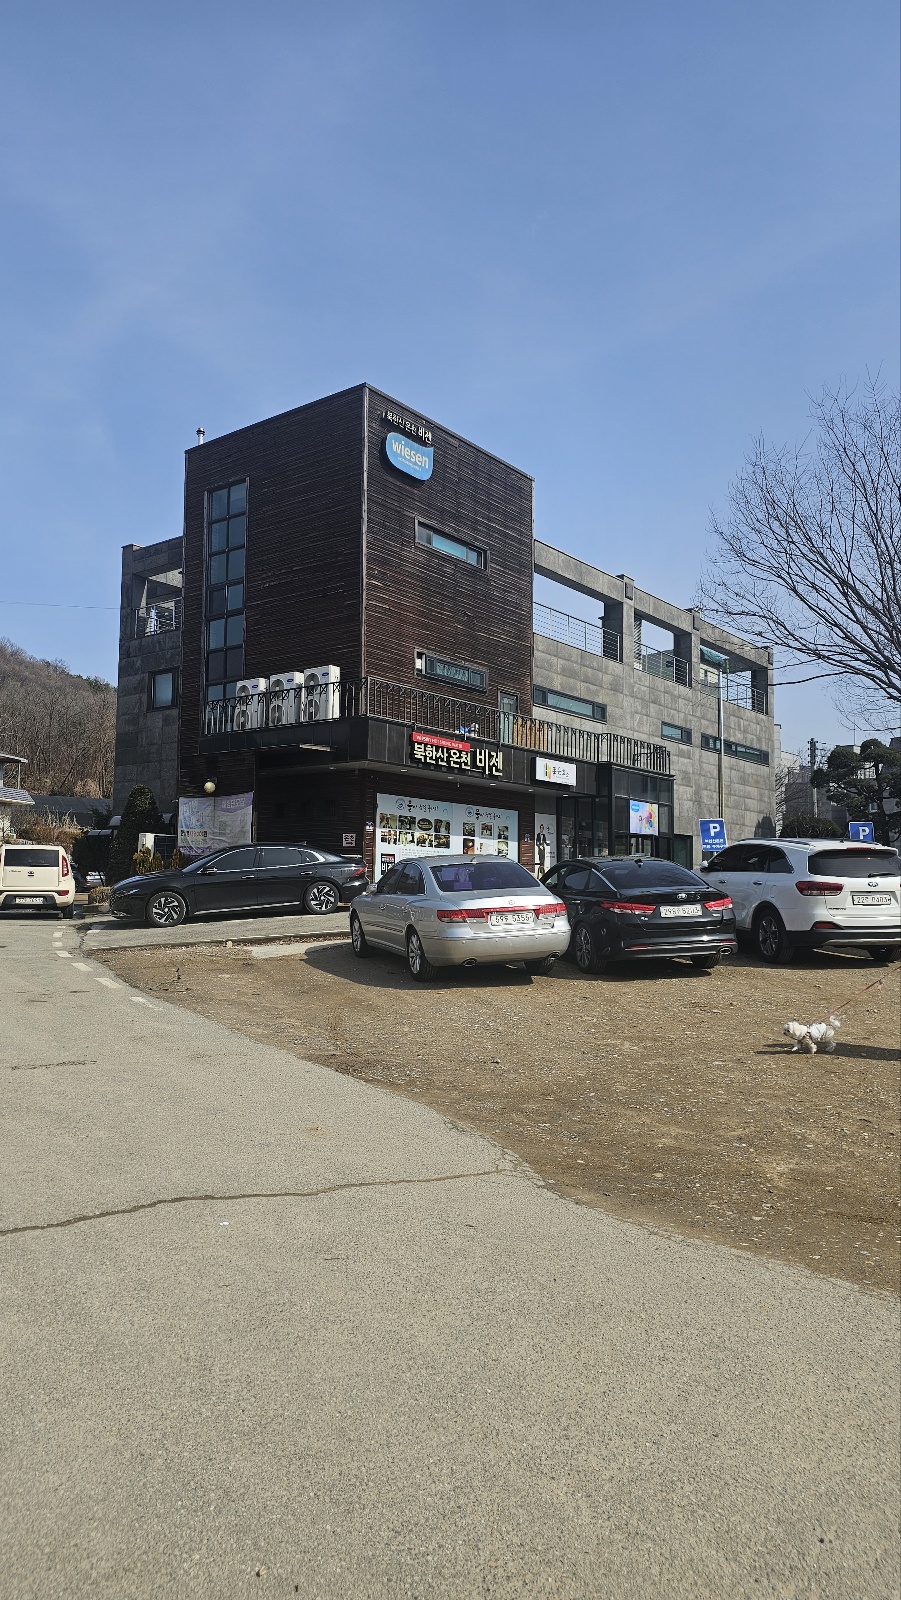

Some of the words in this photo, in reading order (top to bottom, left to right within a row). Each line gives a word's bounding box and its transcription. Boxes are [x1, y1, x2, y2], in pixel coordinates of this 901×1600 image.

[418, 426, 432, 445] 비젠
[392, 439, 429, 469] wiesen
[476, 748, 503, 776] 비젠
[709, 823, 721, 837] P
[858, 826, 870, 840] P
